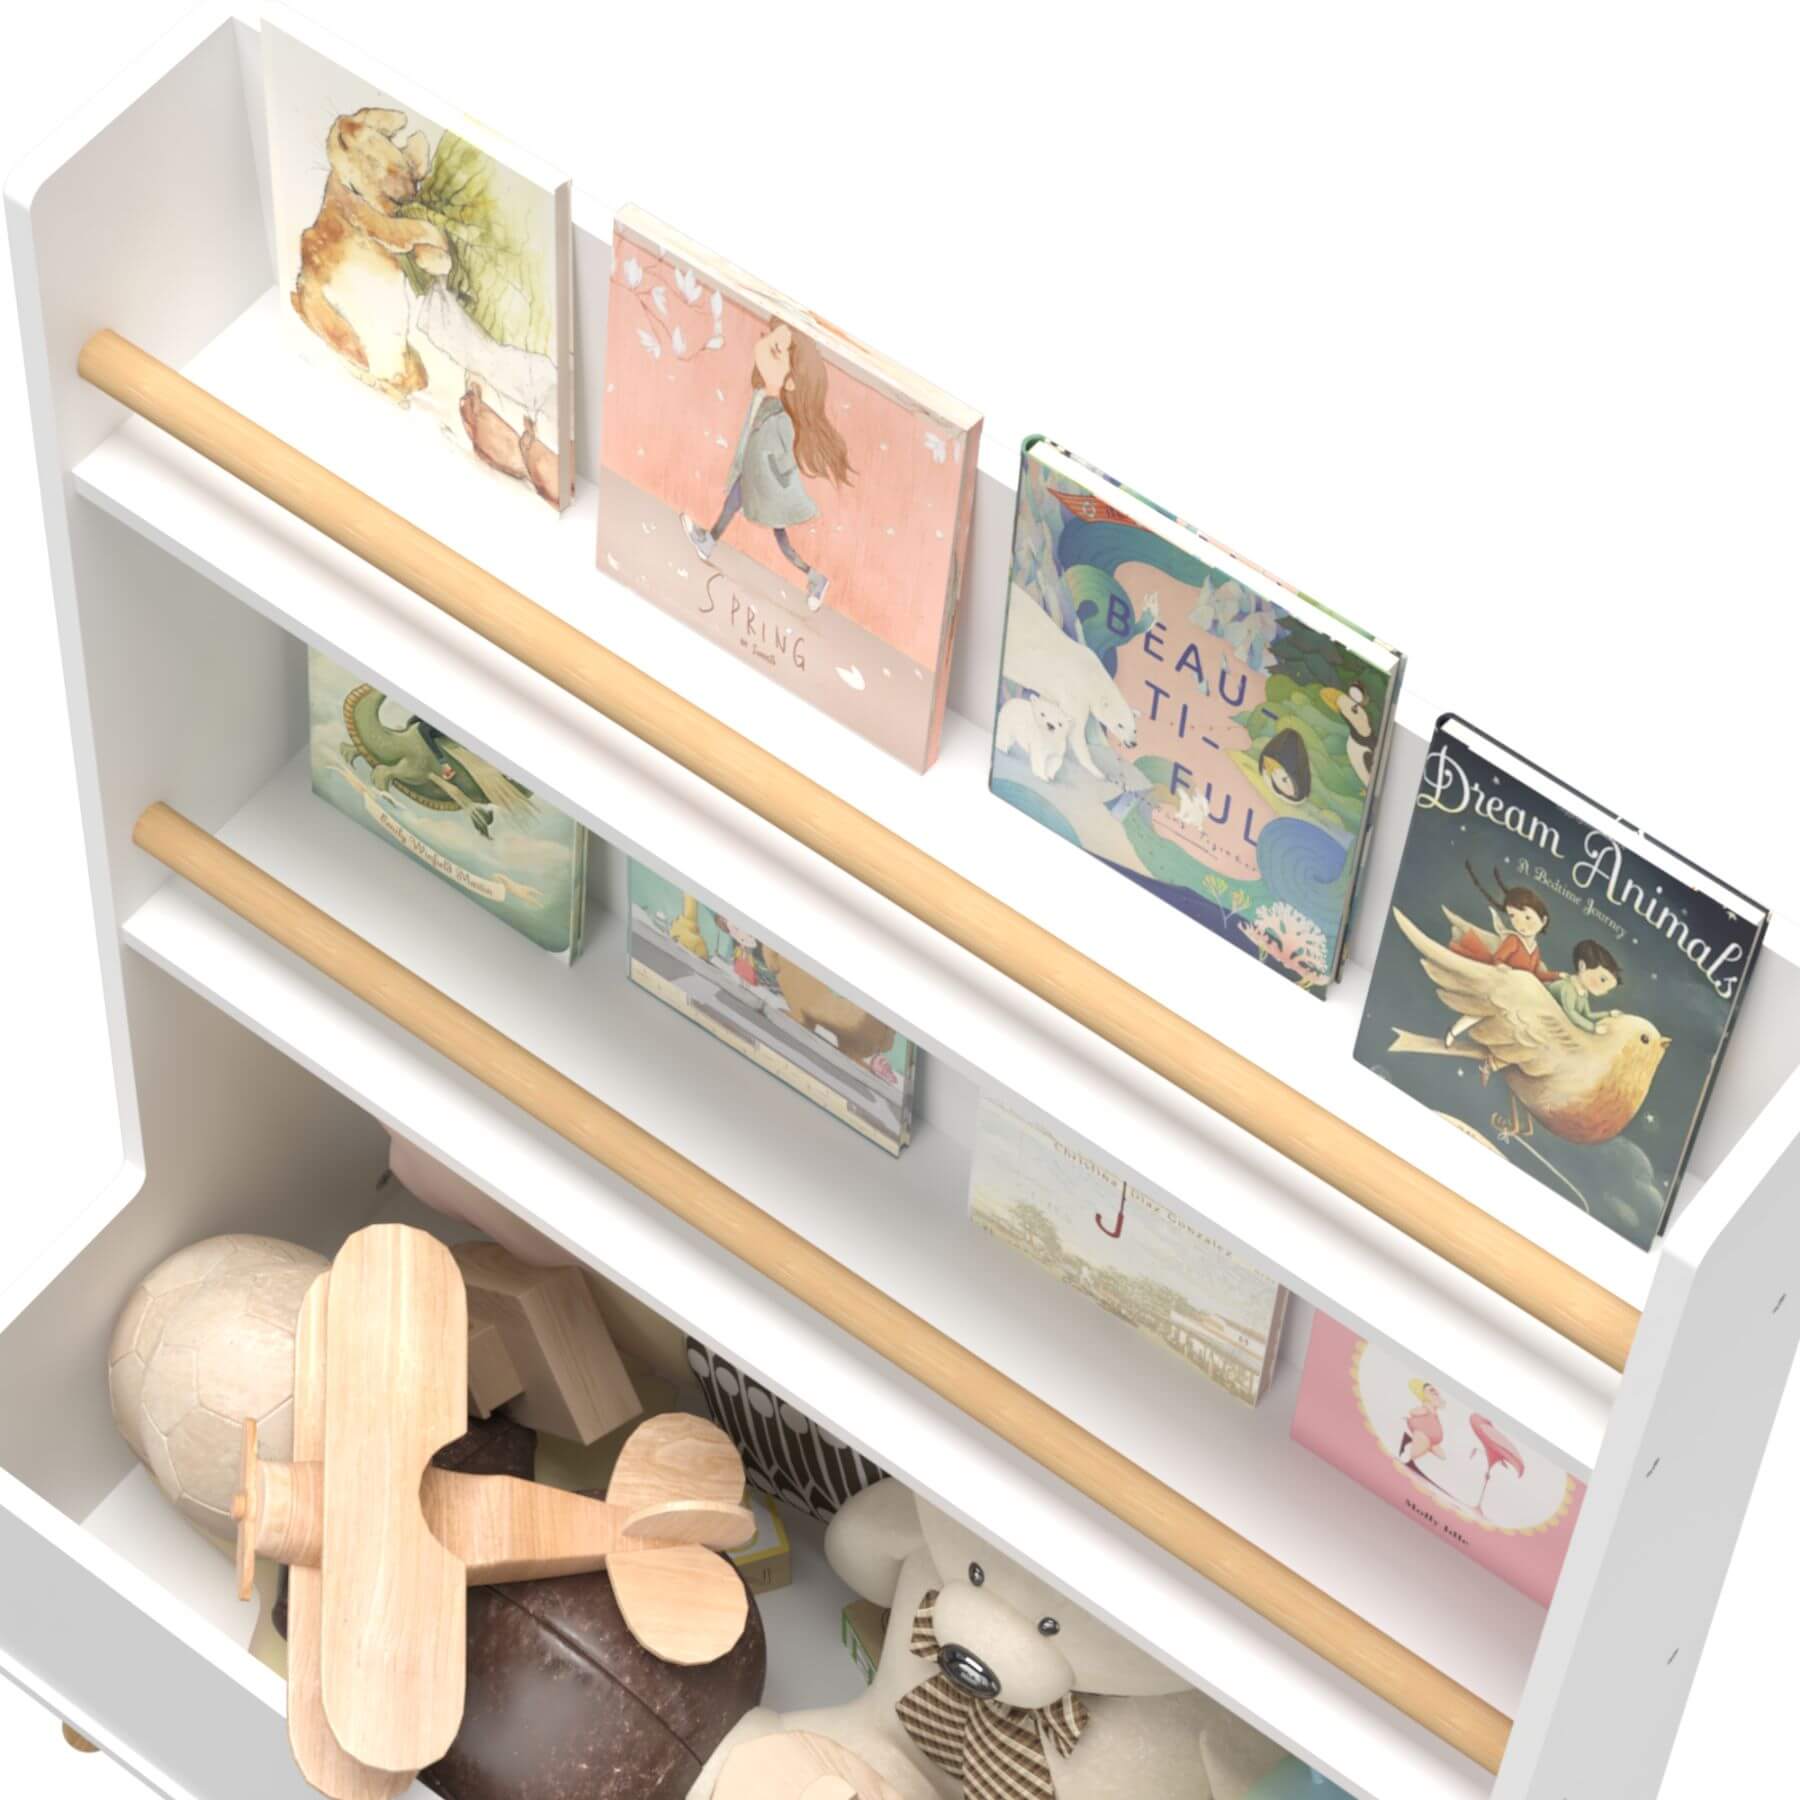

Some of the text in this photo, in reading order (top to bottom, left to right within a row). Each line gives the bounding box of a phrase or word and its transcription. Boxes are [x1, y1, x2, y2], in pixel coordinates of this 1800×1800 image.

[698, 572, 806, 671] SPRING
[1145, 680, 1220, 749] TI-
[1170, 762, 1257, 847] FUL
[1416, 745, 1565, 859] Dream
[1572, 829, 1743, 998] Animals
[1534, 866, 1582, 904] Bedtime
[1584, 897, 1627, 939] Journey
